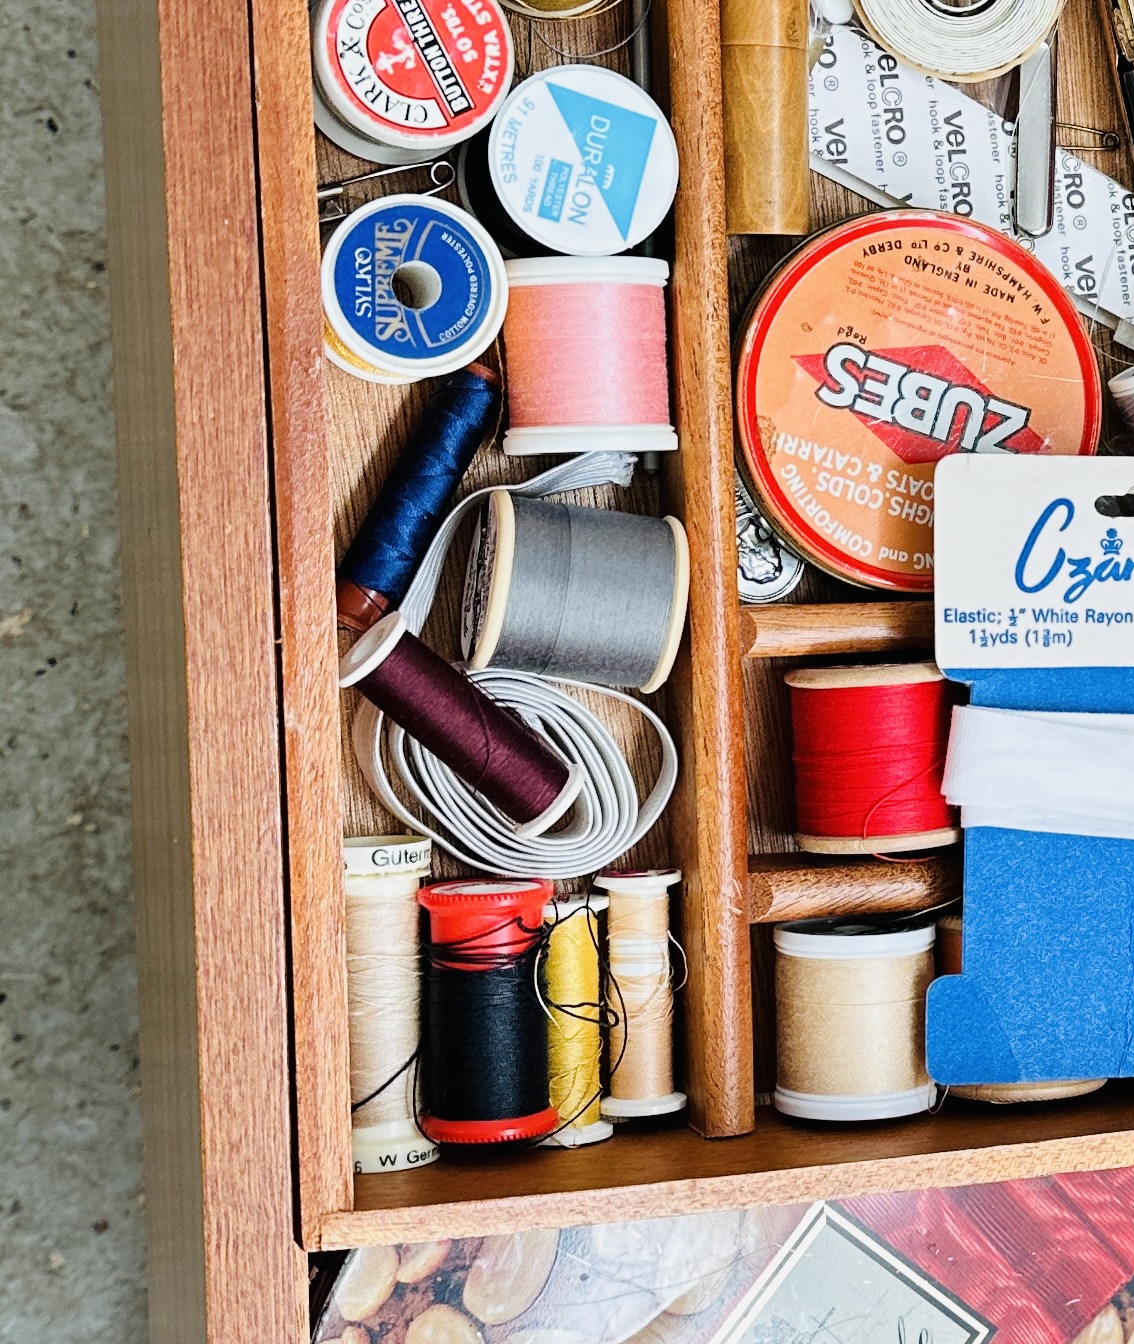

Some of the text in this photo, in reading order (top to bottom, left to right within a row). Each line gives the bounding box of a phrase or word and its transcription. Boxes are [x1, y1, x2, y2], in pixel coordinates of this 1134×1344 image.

[339, 37, 366, 60] &
[477, 29, 502, 95] EXTRA
[421, 40, 472, 115] BUTTON
[865, 64, 876, 75] &
[348, 64, 429, 125] CLARK
[866, 79, 877, 109] loop
[929, 101, 939, 134] hook
[498, 97, 536, 184] 91 METRES
[871, 113, 885, 173] fastener
[933, 139, 944, 150] &
[523, 154, 544, 214] 100 YARDS
[567, 114, 611, 227] DURALON
[935, 155, 945, 184] loop
[543, 171, 558, 207] THREAD
[551, 165, 569, 218] POLYESTER
[995, 174, 1005, 208] hook
[1110, 203, 1121, 214] &
[862, 239, 904, 256] DERBY
[1112, 217, 1123, 246] loop
[954, 245, 965, 256] &
[955, 262, 972, 274] BY
[1060, 246, 1071, 280] hook
[354, 246, 373, 319] SYLKO
[374, 217, 412, 342] SUPREME
[439, 231, 480, 342] COTTON COVERED POLYESTER
[903, 255, 1017, 304] MADE IN ENGLAND
[969, 253, 1031, 299] HAMPSHIRE
[1117, 250, 1131, 307] fastener
[814, 342, 1032, 454] ZUBES
[866, 463, 881, 479] &
[780, 462, 909, 563] and COMFORTING
[943, 607, 1003, 625] Elastic;
[1032, 608, 1080, 624] White
[1084, 609, 1134, 625] Rayon
[378, 1153, 398, 1168] W
